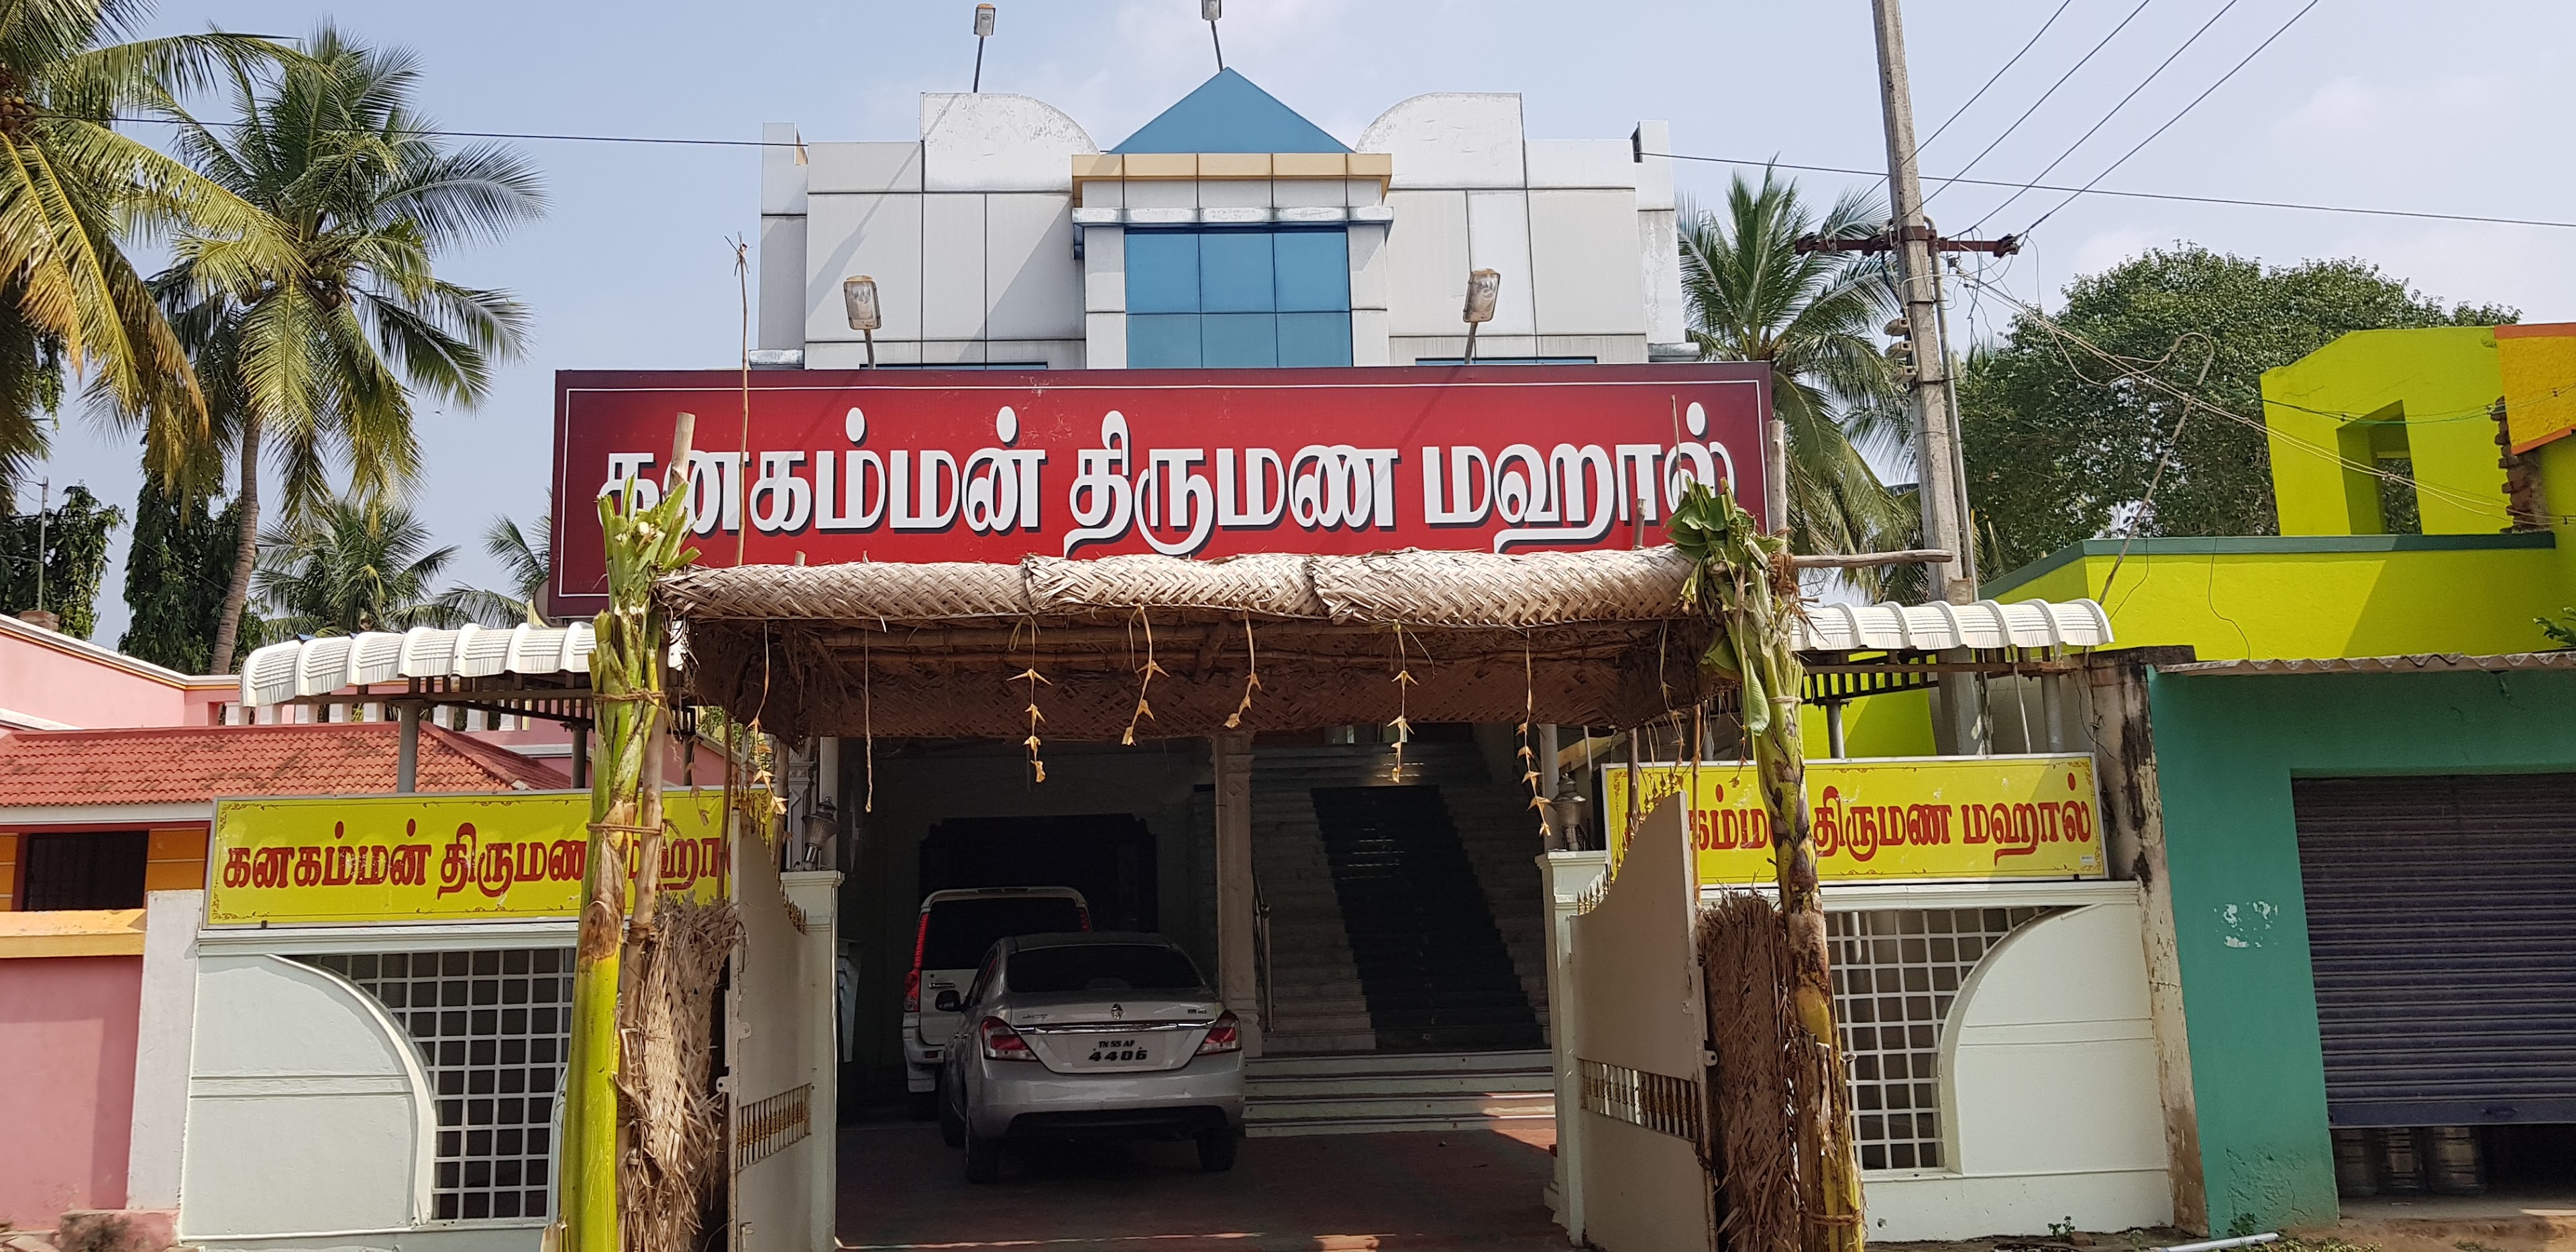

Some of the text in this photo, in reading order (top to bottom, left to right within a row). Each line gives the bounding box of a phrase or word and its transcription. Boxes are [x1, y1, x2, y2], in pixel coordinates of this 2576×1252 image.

[598, 401, 1737, 558] கனகம்மன் திருமண மஹால்
[223, 819, 431, 889] கனகம்மன்
[436, 822, 585, 900] திருமண
[1813, 785, 1953, 862] திருமண
[1962, 773, 2092, 866] மஹால்
[1088, 1049, 1148, 1062] 4406
